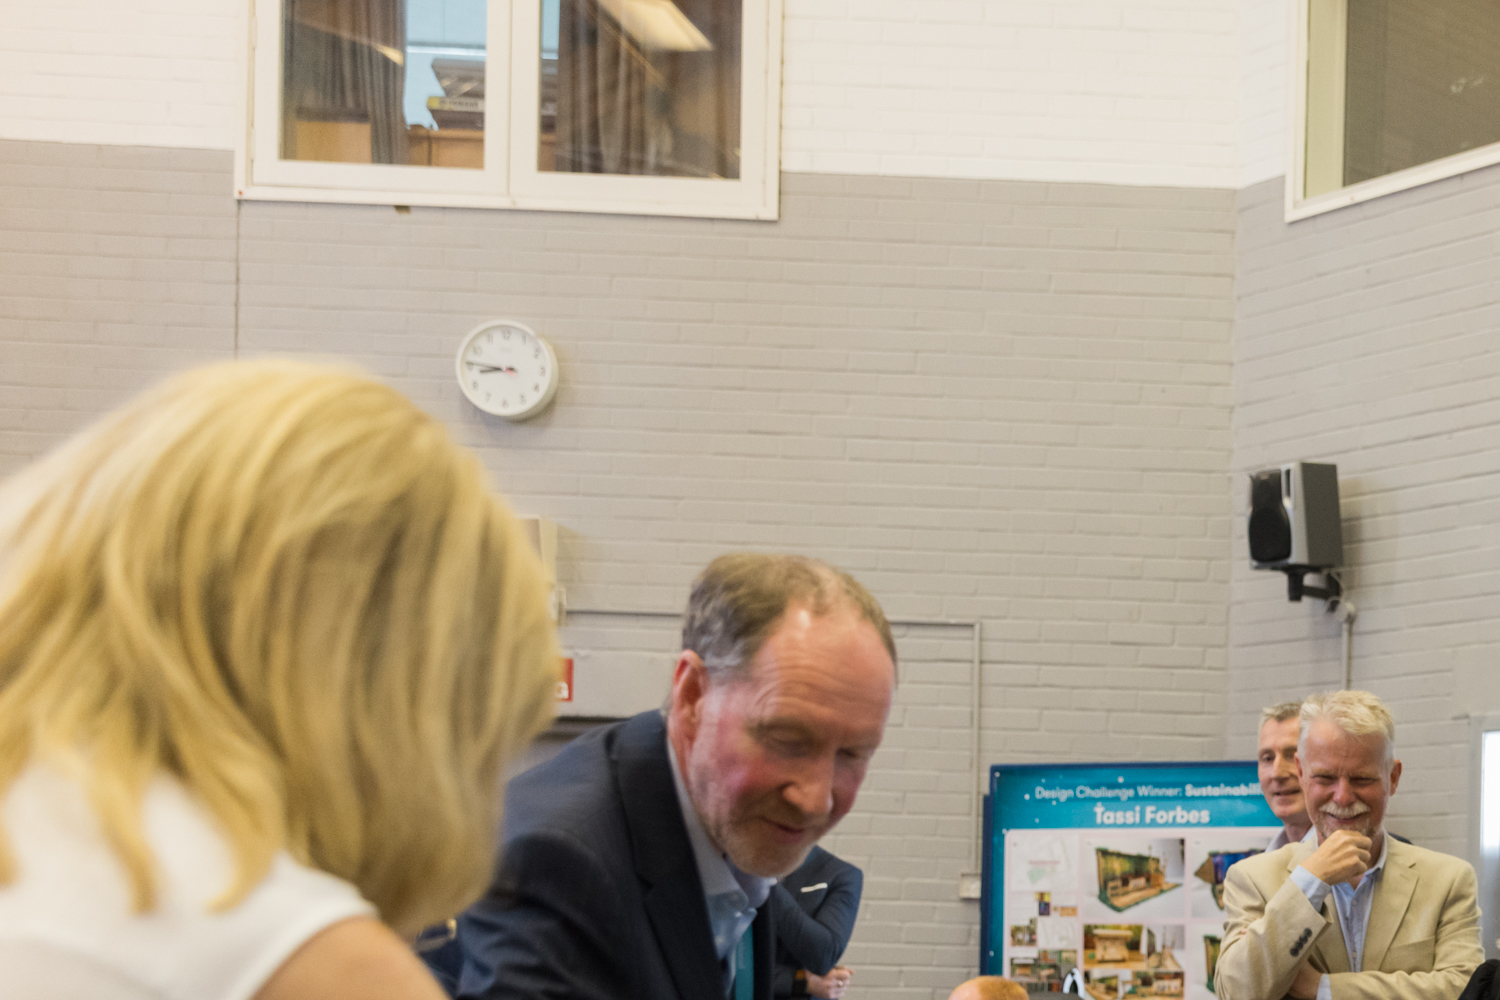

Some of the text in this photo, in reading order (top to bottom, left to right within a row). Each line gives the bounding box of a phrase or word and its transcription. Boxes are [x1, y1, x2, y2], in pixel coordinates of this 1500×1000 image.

[1035, 783, 1263, 802] Design Challenge Winner: Sustainabili
[1094, 804, 1210, 824] Tassi Forbes
